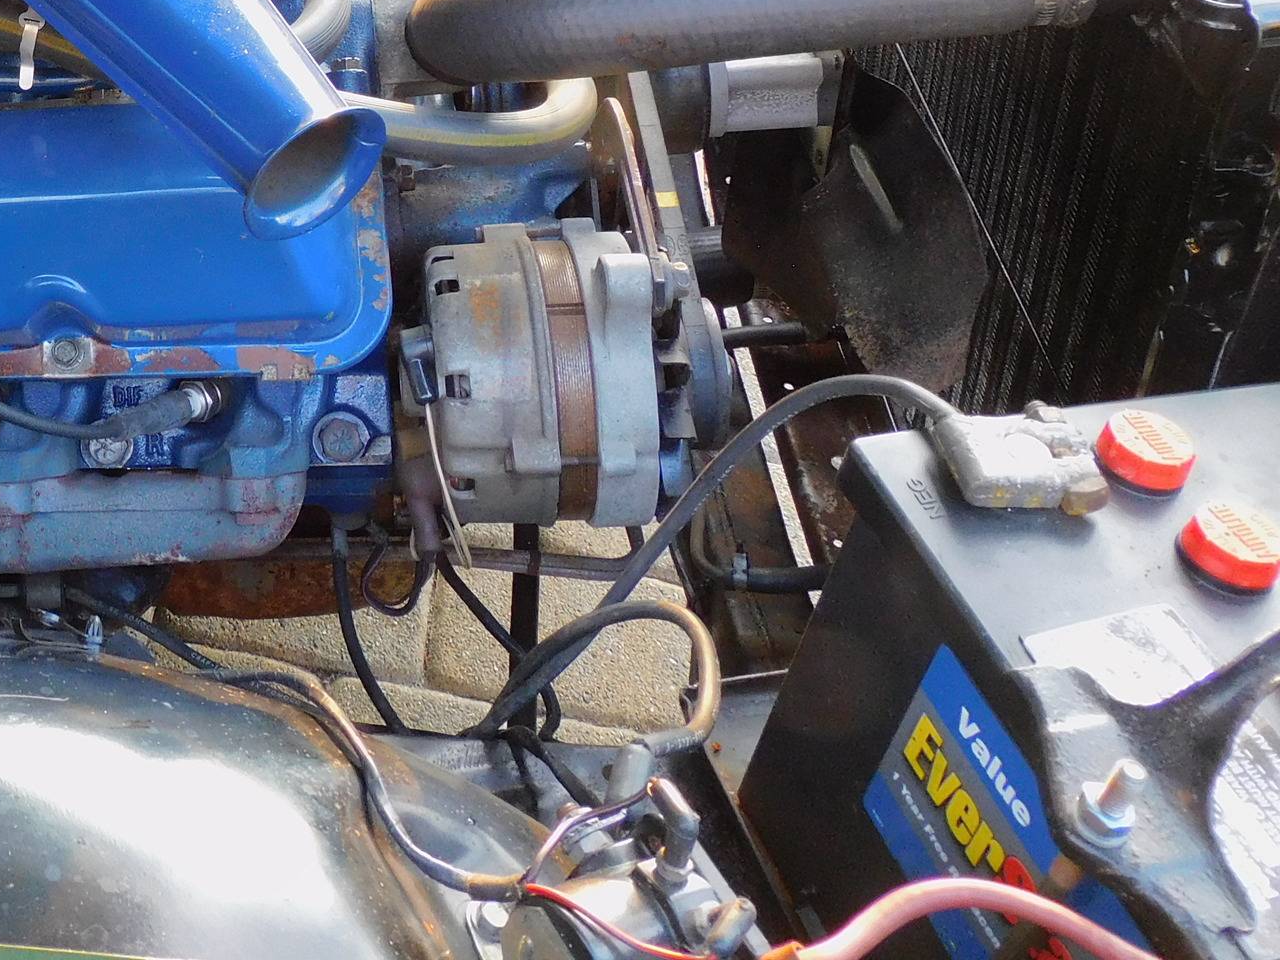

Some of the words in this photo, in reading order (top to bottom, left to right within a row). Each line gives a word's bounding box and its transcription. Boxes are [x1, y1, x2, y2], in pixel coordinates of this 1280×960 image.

[906, 478, 944, 519] NEG
[958, 705, 1031, 828] Value
[901, 783, 925, 821] Year
[924, 824, 948, 862] Free
